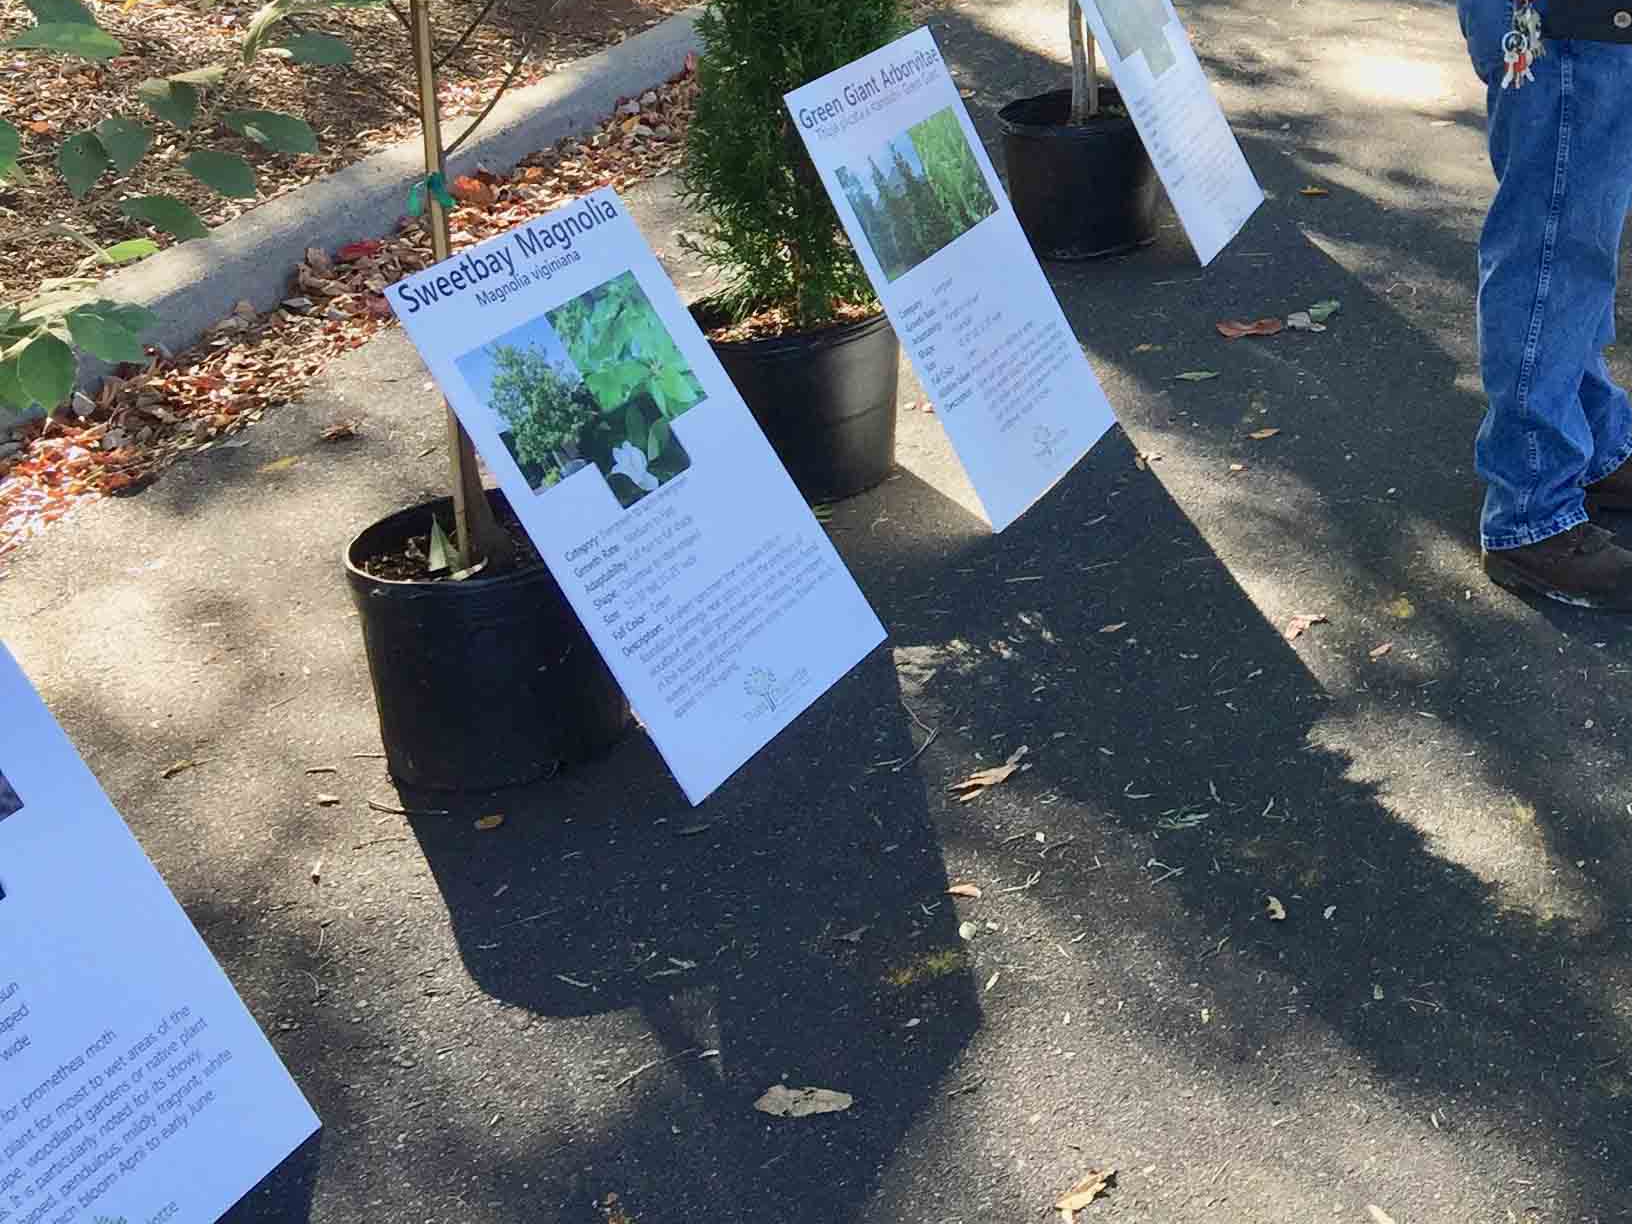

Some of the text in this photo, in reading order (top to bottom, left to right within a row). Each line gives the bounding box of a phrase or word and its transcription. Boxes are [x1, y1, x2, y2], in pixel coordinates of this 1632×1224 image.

[799, 97, 843, 129] Green
[843, 75, 881, 106] Giant
[881, 48, 939, 89] Arborvitae
[398, 198, 618, 313] Sweetbay Magnolia
[475, 249, 582, 306] Magnolia viginiana
[21, 1056, 85, 1111] promethea
[86, 1027, 117, 1057] moth
[26, 1116, 86, 1167] woodland
[85, 1080, 131, 1125] gardens
[131, 1066, 144, 1083] or
[145, 1040, 179, 1073] native
[179, 1016, 208, 1047] plant
[55, 1085, 89, 1115] moist
[88, 1074, 104, 1091] to
[103, 1056, 128, 1078] wet
[127, 1032, 158, 1062] areas
[157, 1016, 171, 1035] of
[169, 1004, 191, 1025] the
[122, 1111, 158, 1145] mildly
[202, 1048, 232, 1079] white
[35, 1134, 98, 1190] particularly
[99, 1103, 134, 1137] noted
[133, 1089, 151, 1108] for
[151, 1077, 167, 1094] its
[167, 1048, 203, 1081] showy
[78, 1089, 216, 1209] bloom April to early June
